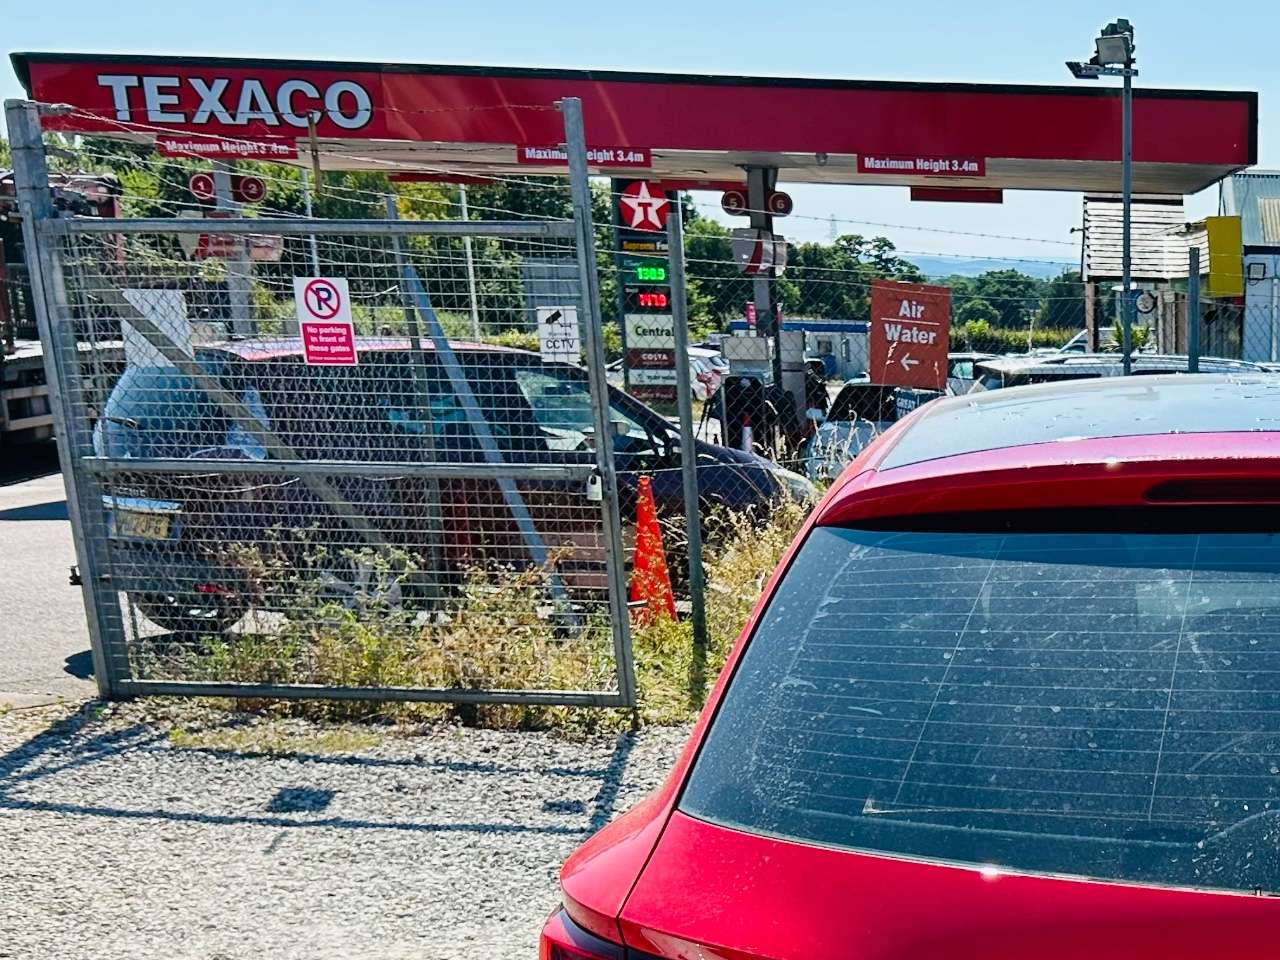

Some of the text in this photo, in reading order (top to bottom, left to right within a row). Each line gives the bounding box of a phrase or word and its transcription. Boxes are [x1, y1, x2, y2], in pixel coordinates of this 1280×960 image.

[97, 74, 372, 129] TEXACO
[165, 140, 219, 152] Maximum
[221, 141, 259, 156] Height
[525, 147, 645, 163] Maximu eight 3.4m
[864, 157, 978, 172] Maximum Height 3.4m
[898, 299, 925, 318] Air
[319, 326, 347, 334] parking
[884, 323, 937, 344] Water
[545, 339, 575, 349] CCTV
[641, 353, 668, 361] COSTA
